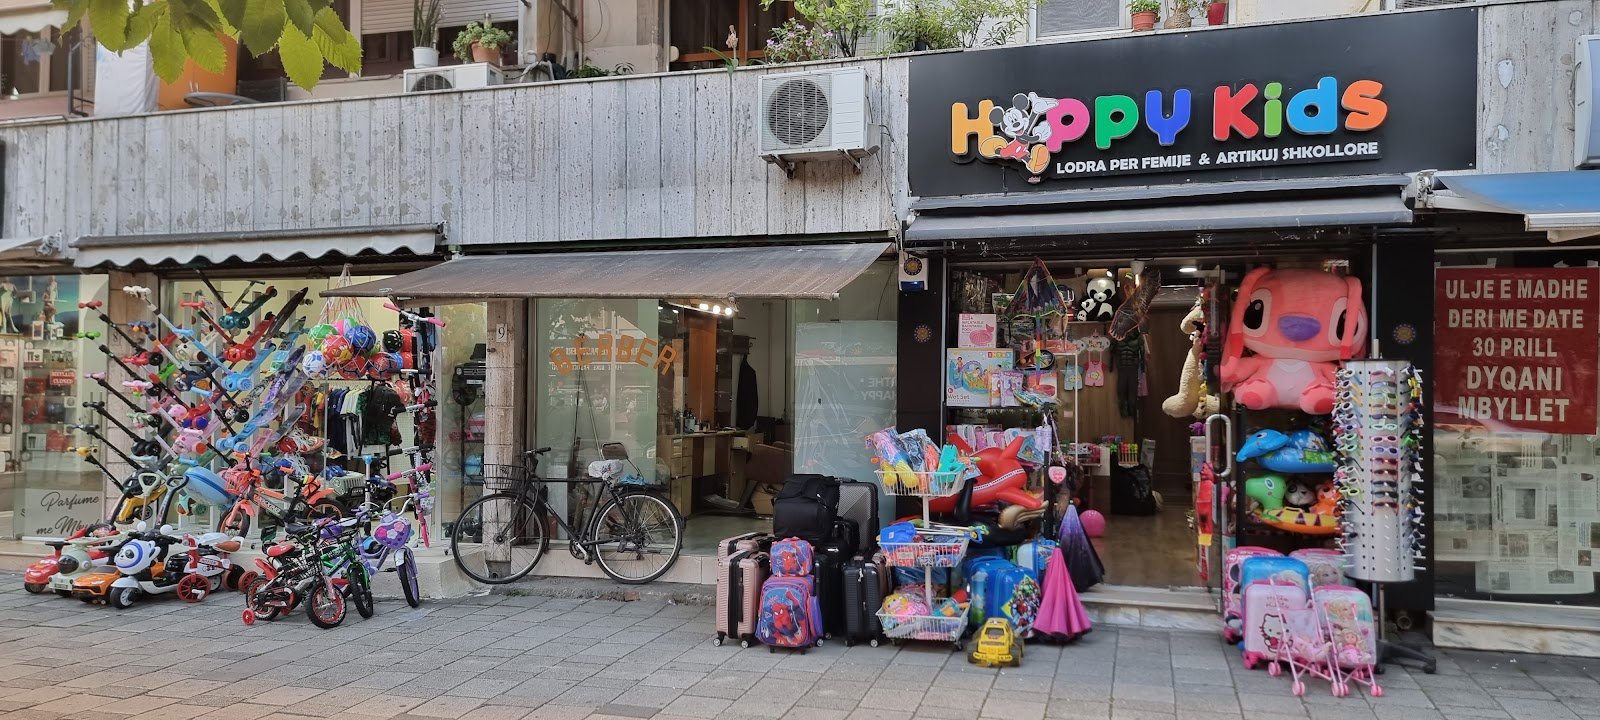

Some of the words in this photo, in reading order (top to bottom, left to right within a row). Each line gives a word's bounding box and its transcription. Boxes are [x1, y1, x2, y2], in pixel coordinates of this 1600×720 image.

[951, 88, 1193, 156] HPPY
[1213, 76, 1389, 142] Kids
[1056, 160, 1107, 174] LODRA
[1109, 157, 1139, 171] PER
[1141, 154, 1192, 170] FEMIJE
[1198, 152, 1211, 166] &
[1215, 148, 1279, 165] ARTIKUJ
[1282, 141, 1379, 160] SHKOLLORE
[1445, 279, 1495, 299] ULJE
[1500, 279, 1512, 299] E
[1517, 278, 1588, 299] MADHE
[1448, 308, 1493, 328] DERI
[1500, 308, 1527, 329] ME
[1533, 308, 1584, 329] DATE
[498, 326, 505, 340] 9
[1472, 337, 1495, 357] 30
[1500, 337, 1558, 358] PRILL
[1466, 365, 1562, 393] DYQANI
[1458, 396, 1570, 422] MBYLLET
[40, 491, 99, 511] Parfume
[36, 526, 53, 535] me
